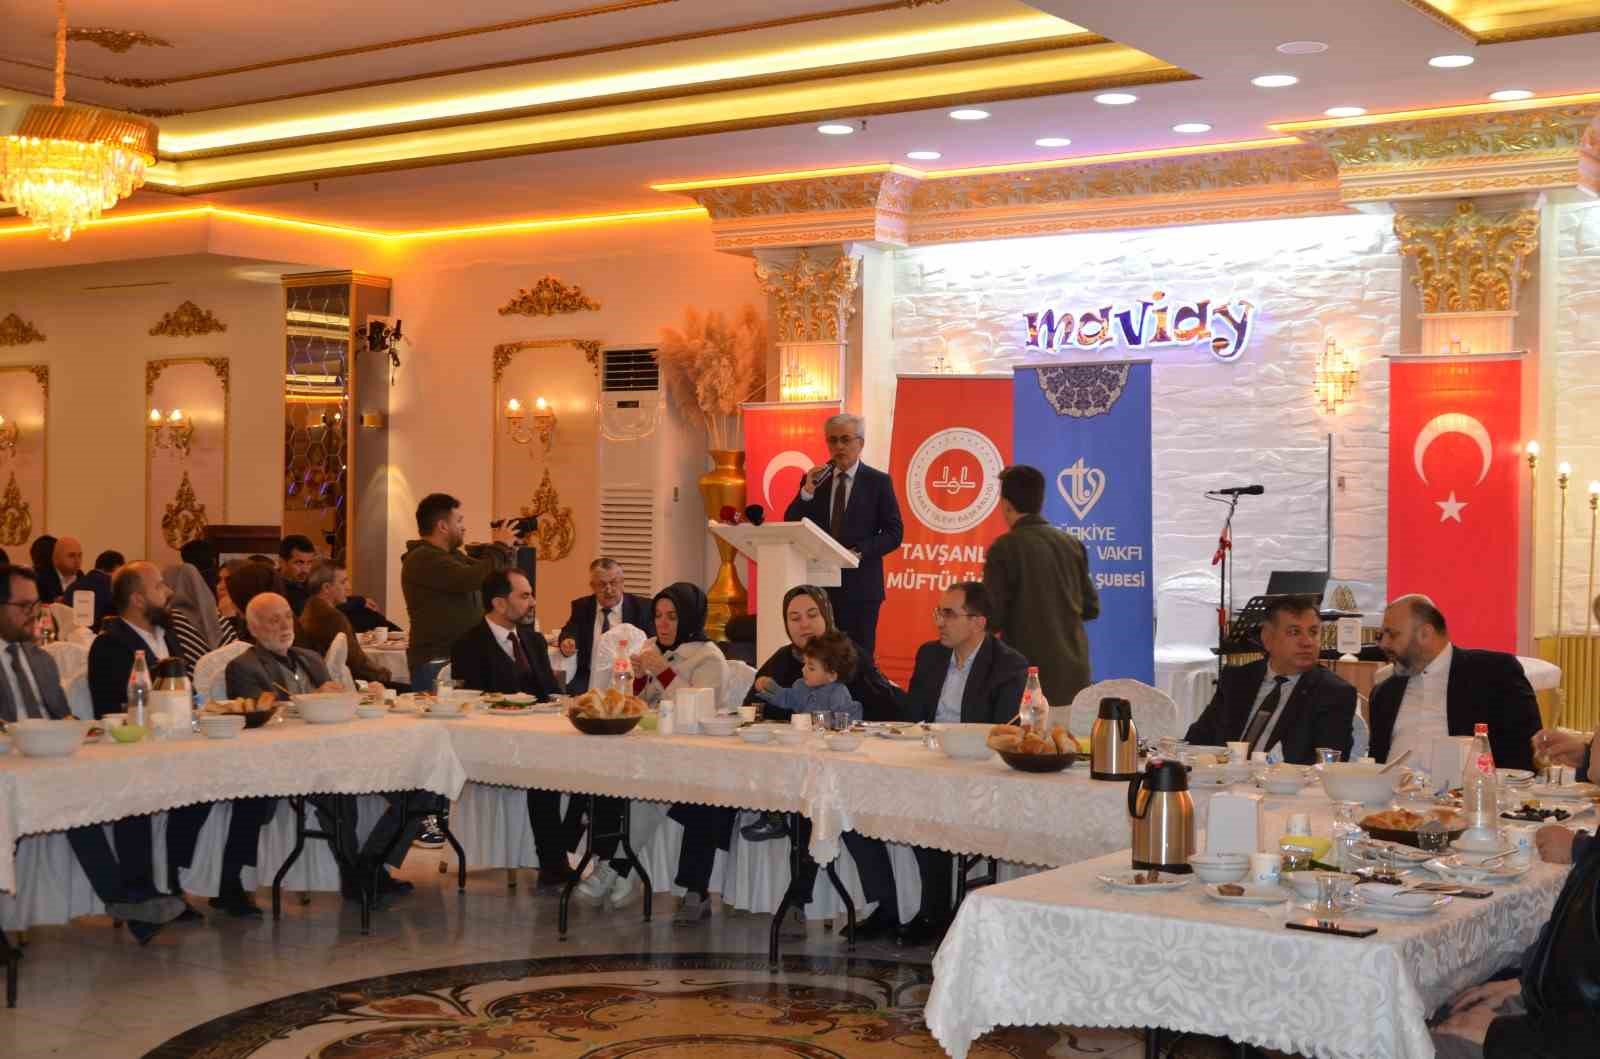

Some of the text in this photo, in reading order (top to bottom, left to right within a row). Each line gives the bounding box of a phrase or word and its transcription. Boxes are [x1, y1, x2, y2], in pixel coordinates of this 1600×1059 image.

[901, 543, 986, 566] TAVŞANL
[1096, 545, 1143, 561] VAKFI
[1095, 570, 1145, 590] ŞUBESİ
